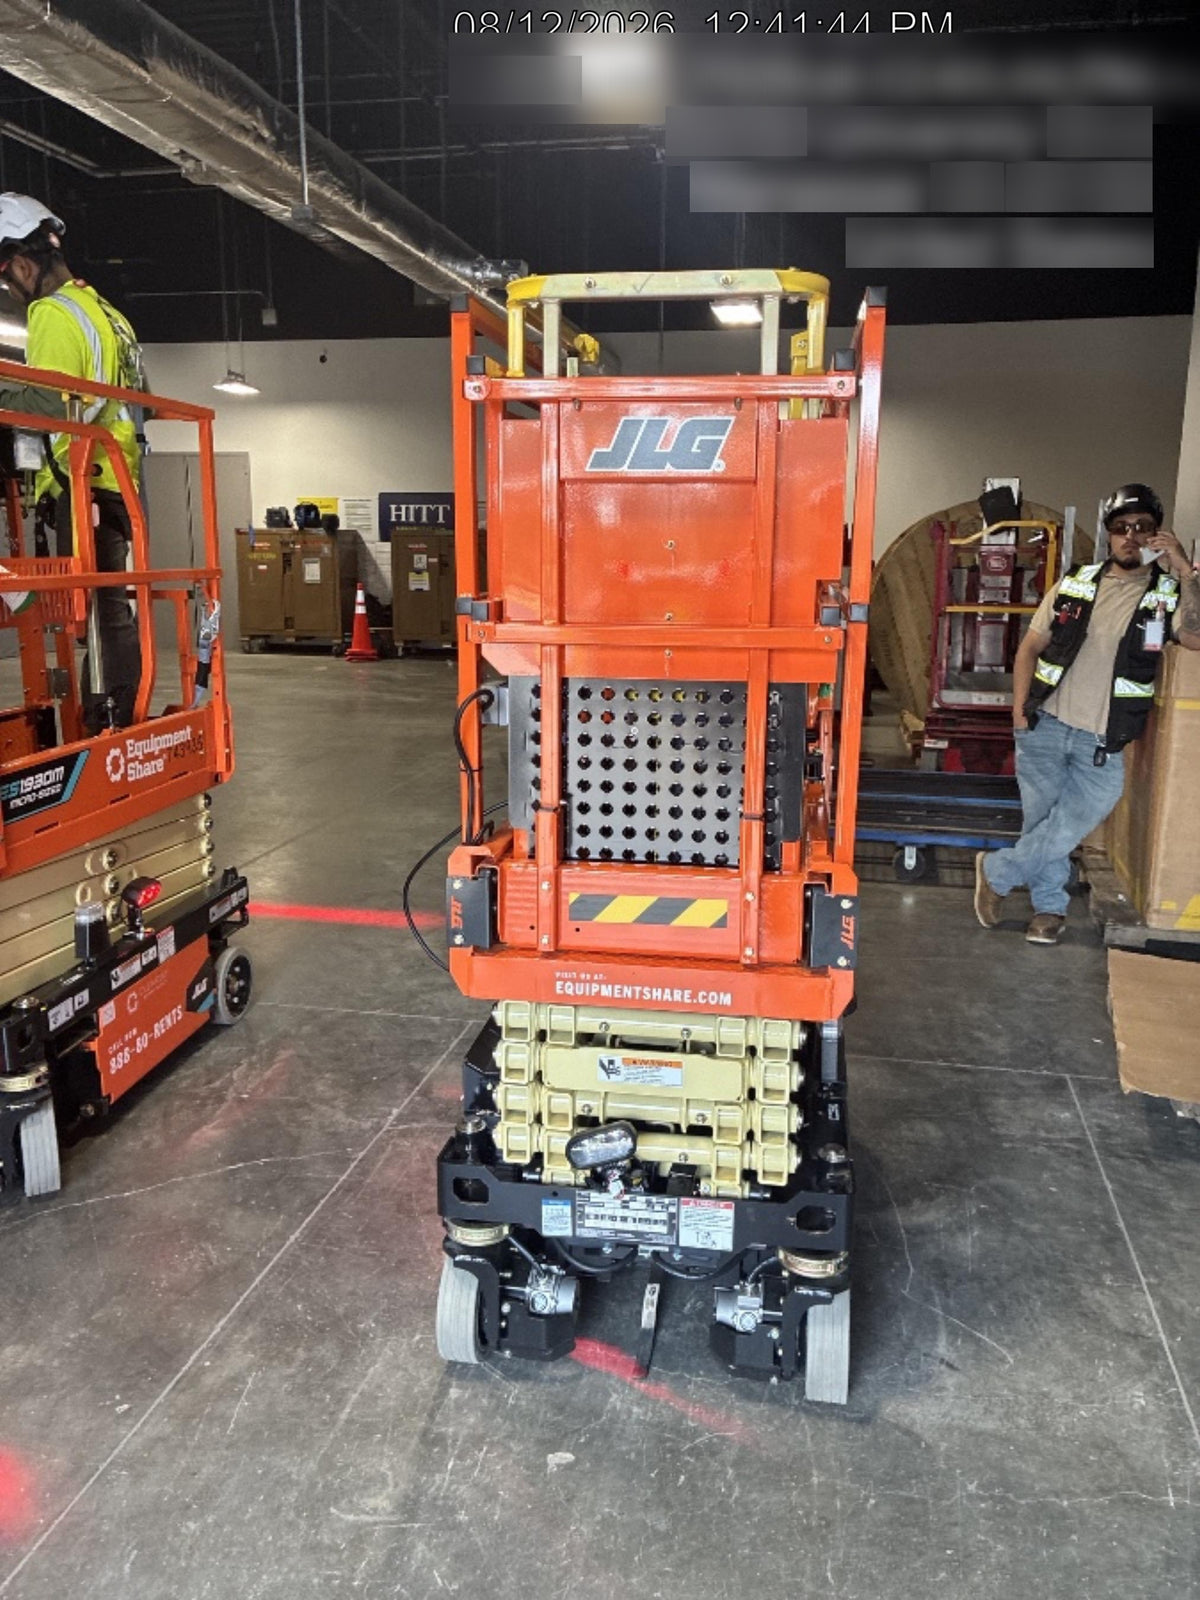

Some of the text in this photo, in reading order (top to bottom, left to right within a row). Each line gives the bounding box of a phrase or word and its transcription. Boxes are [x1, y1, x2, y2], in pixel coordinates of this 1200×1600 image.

[585, 416, 736, 472] JLG
[389, 504, 450, 524] HITT
[126, 726, 192, 759] Equipment
[127, 758, 165, 782] Share
[450, 895, 463, 929] JLG
[840, 915, 855, 951] JLG
[555, 981, 732, 1006] EQUIPMENTSHARE.COM
